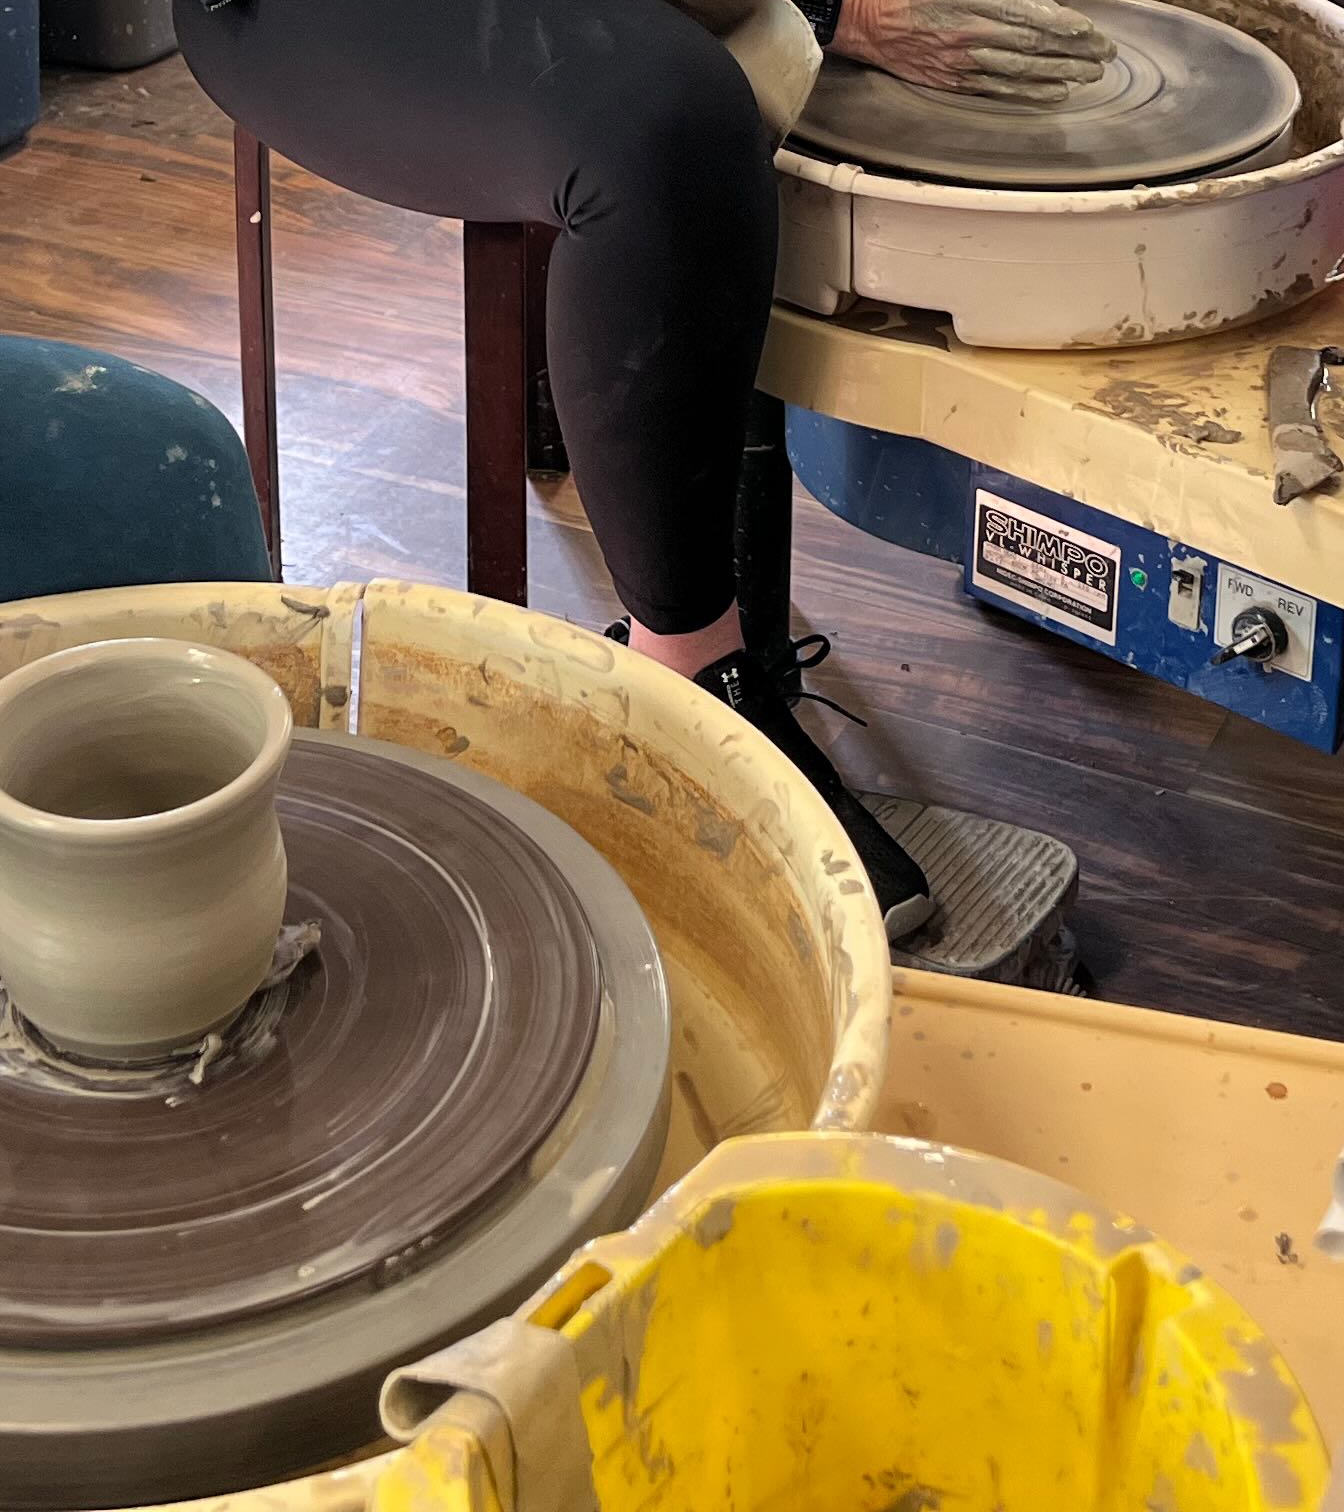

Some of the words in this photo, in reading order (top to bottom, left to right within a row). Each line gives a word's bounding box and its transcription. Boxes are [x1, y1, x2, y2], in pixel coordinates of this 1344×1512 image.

[985, 509, 1109, 579] SHIMPO
[1227, 577, 1254, 597] FWD
[1277, 597, 1305, 616] REV
